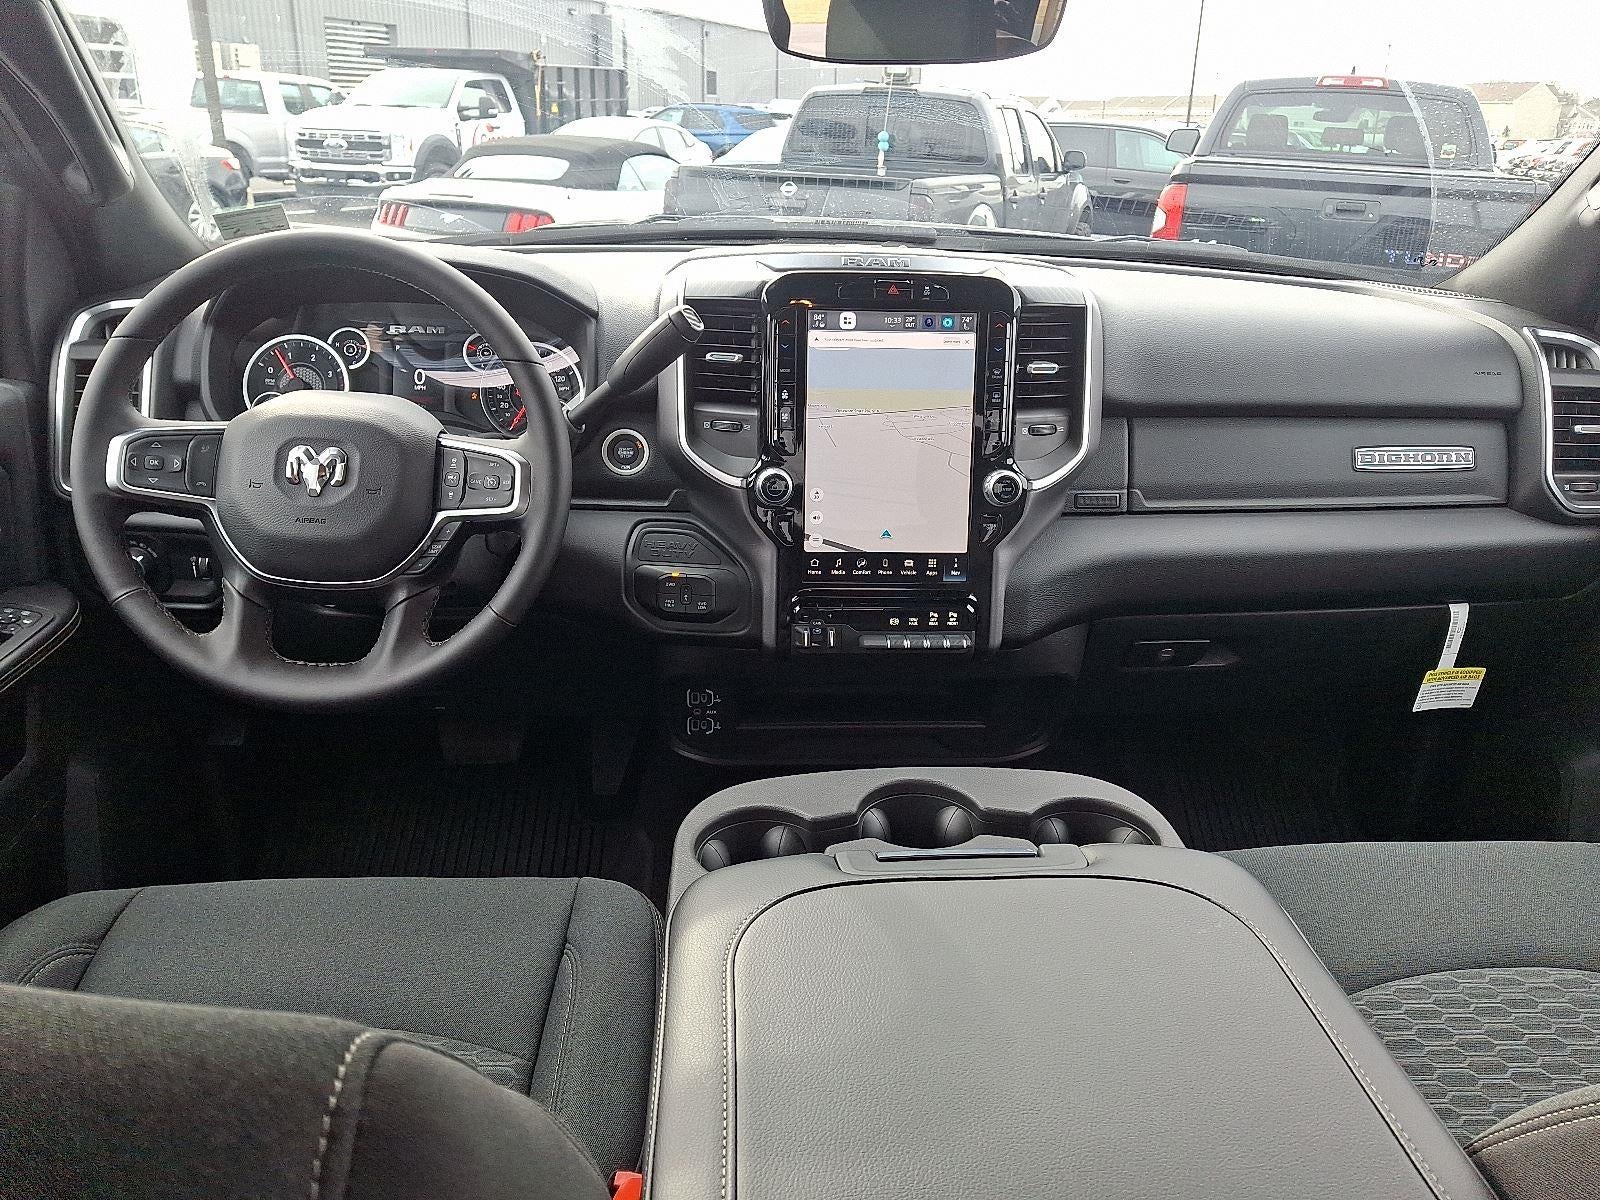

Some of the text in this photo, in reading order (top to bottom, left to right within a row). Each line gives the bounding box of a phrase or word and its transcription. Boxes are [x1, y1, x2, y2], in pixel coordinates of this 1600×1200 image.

[840, 255, 911, 268] RAM
[387, 325, 446, 334] RAM
[287, 352, 292, 360] 1
[310, 354, 316, 362] 2
[327, 370, 334, 378] 3
[413, 368, 426, 385] 0
[554, 375, 566, 383] 120
[149, 458, 160, 466] OK
[1359, 452, 1472, 464] BIGHORN
[295, 516, 327, 525] AIRBAG
